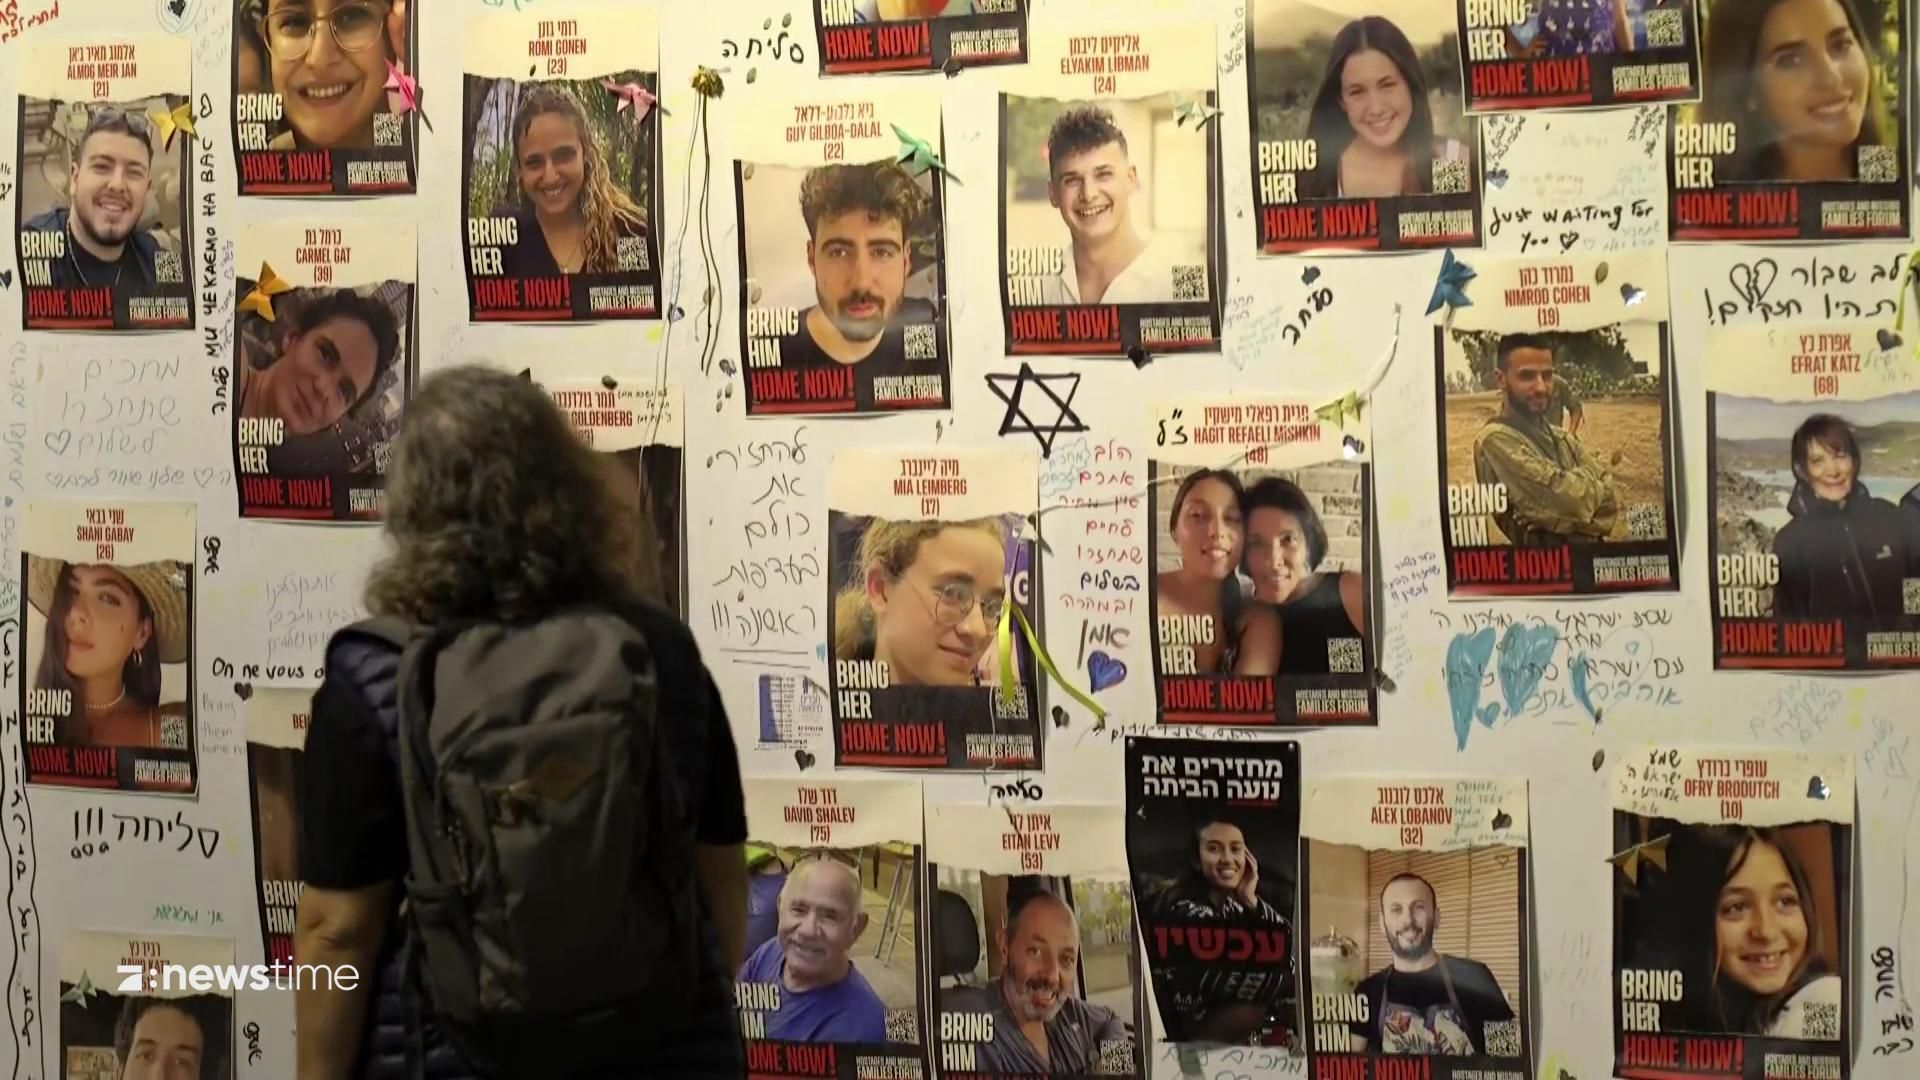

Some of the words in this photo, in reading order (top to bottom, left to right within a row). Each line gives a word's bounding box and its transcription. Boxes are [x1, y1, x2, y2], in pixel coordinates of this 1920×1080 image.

[822, 0, 855, 26] HIM
[528, 40, 553, 56] ROMI
[555, 38, 587, 56] GONEN
[824, 27, 874, 60] HOME
[878, 21, 930, 57] NOW!
[1467, 28, 1506, 61] HER
[67, 63, 95, 79] ALMOG
[98, 63, 119, 78] MEIR
[121, 62, 137, 78] JAN
[547, 59, 567, 76] (23)
[1061, 56, 1105, 75] ELYAKIM
[1108, 54, 1150, 73] LIBMAN
[1471, 63, 1527, 97] HOME
[1532, 54, 1590, 93] NOW!
[93, 81, 109, 98] (21)
[1094, 76, 1116, 95] (24)
[237, 94, 283, 121] BRING
[237, 122, 268, 151] HER
[786, 126, 807, 143] GUY
[809, 121, 882, 142] GILBOA-DALAL
[1675, 122, 1736, 155] BRING
[823, 142, 844, 161] (22)
[1258, 139, 1317, 173] BRING
[242, 153, 284, 182] HOME
[287, 149, 333, 182] NOW!
[1675, 157, 1714, 189] HER
[1260, 173, 1298, 205] HER
[1676, 192, 1732, 226] HOME
[1738, 187, 1799, 225] NOW!
[1263, 206, 1317, 241] HOME
[1322, 200, 1378, 238] NOW!
[21, 230, 65, 258] BRING
[296, 248, 331, 264] CARMEL
[334, 247, 351, 263] GAT
[23, 259, 52, 287] HIM
[313, 265, 332, 284] (39)
[28, 289, 68, 317] HOME
[71, 287, 112, 317] NOW!
[1504, 287, 1549, 307] NIMROD
[1552, 285, 1591, 304] COHEN
[748, 307, 799, 337] BRING
[1538, 308, 1560, 328] (19)
[750, 337, 782, 368] HIM
[1792, 355, 1827, 375] EFRAT
[1831, 354, 1861, 374] KATZ
[752, 370, 800, 400] HOME
[804, 367, 855, 399] NOW!
[913, 384, 943, 399] FORUM
[1814, 376, 1838, 396] (68)
[238, 417, 284, 446] BRING
[1194, 427, 1225, 444] HAGIT
[1228, 426, 1271, 443] REFAELI
[239, 447, 269, 473] HER
[1245, 446, 1269, 464] (48)
[243, 478, 284, 506] HOME
[288, 476, 332, 507] NOW!
[894, 479, 914, 496] MIA
[916, 478, 967, 495] LEIMBERG
[1448, 482, 1508, 516] BRING
[921, 498, 940, 517] (17)
[77, 527, 103, 542] SHANI
[105, 527, 134, 542] GABAY
[1450, 515, 1489, 547] HIM
[96, 544, 114, 561] (26)
[1453, 551, 1509, 583] HOME
[1514, 545, 1571, 581] NOW!
[1717, 552, 1779, 585] BRING
[1720, 586, 1758, 618] HER
[1721, 621, 1778, 654] HOME
[1784, 618, 1844, 654] NOW!
[835, 660, 889, 690] BRING
[838, 691, 872, 719] HER
[1296, 700, 1336, 715] FAMILIES
[1338, 699, 1369, 714] FORUM
[841, 723, 889, 752] HOME
[895, 720, 946, 754] NOW!
[1141, 755, 1176, 776] את
[1184, 757, 1283, 779] מחזירים
[1143, 778, 1219, 798] הביתה
[1227, 780, 1281, 800] נועה
[1684, 780, 1713, 798] OFRY
[1717, 780, 1779, 799] BRODUTCH
[784, 807, 815, 824] DAVID
[817, 807, 855, 824] SHALEV
[1371, 807, 1397, 825] ALEX
[1401, 806, 1453, 825] LOBANOV
[1720, 800, 1743, 820] (10)
[810, 825, 830, 843] (75)
[1002, 833, 1032, 851] EITAN
[1034, 834, 1061, 851] LEVY
[1400, 827, 1423, 846] (32)
[1021, 852, 1043, 870] (53)
[1155, 926, 1286, 962] עכשיו
[1621, 969, 1683, 1001] BRING
[1312, 993, 1369, 1023] BRING
[1622, 1002, 1660, 1033] HER
[940, 1012, 994, 1042] BRING
[1314, 1023, 1350, 1053] HIM
[942, 1043, 976, 1071] HIM
[1624, 1035, 1679, 1069] HOME
[1685, 1037, 1744, 1071] NOW!
